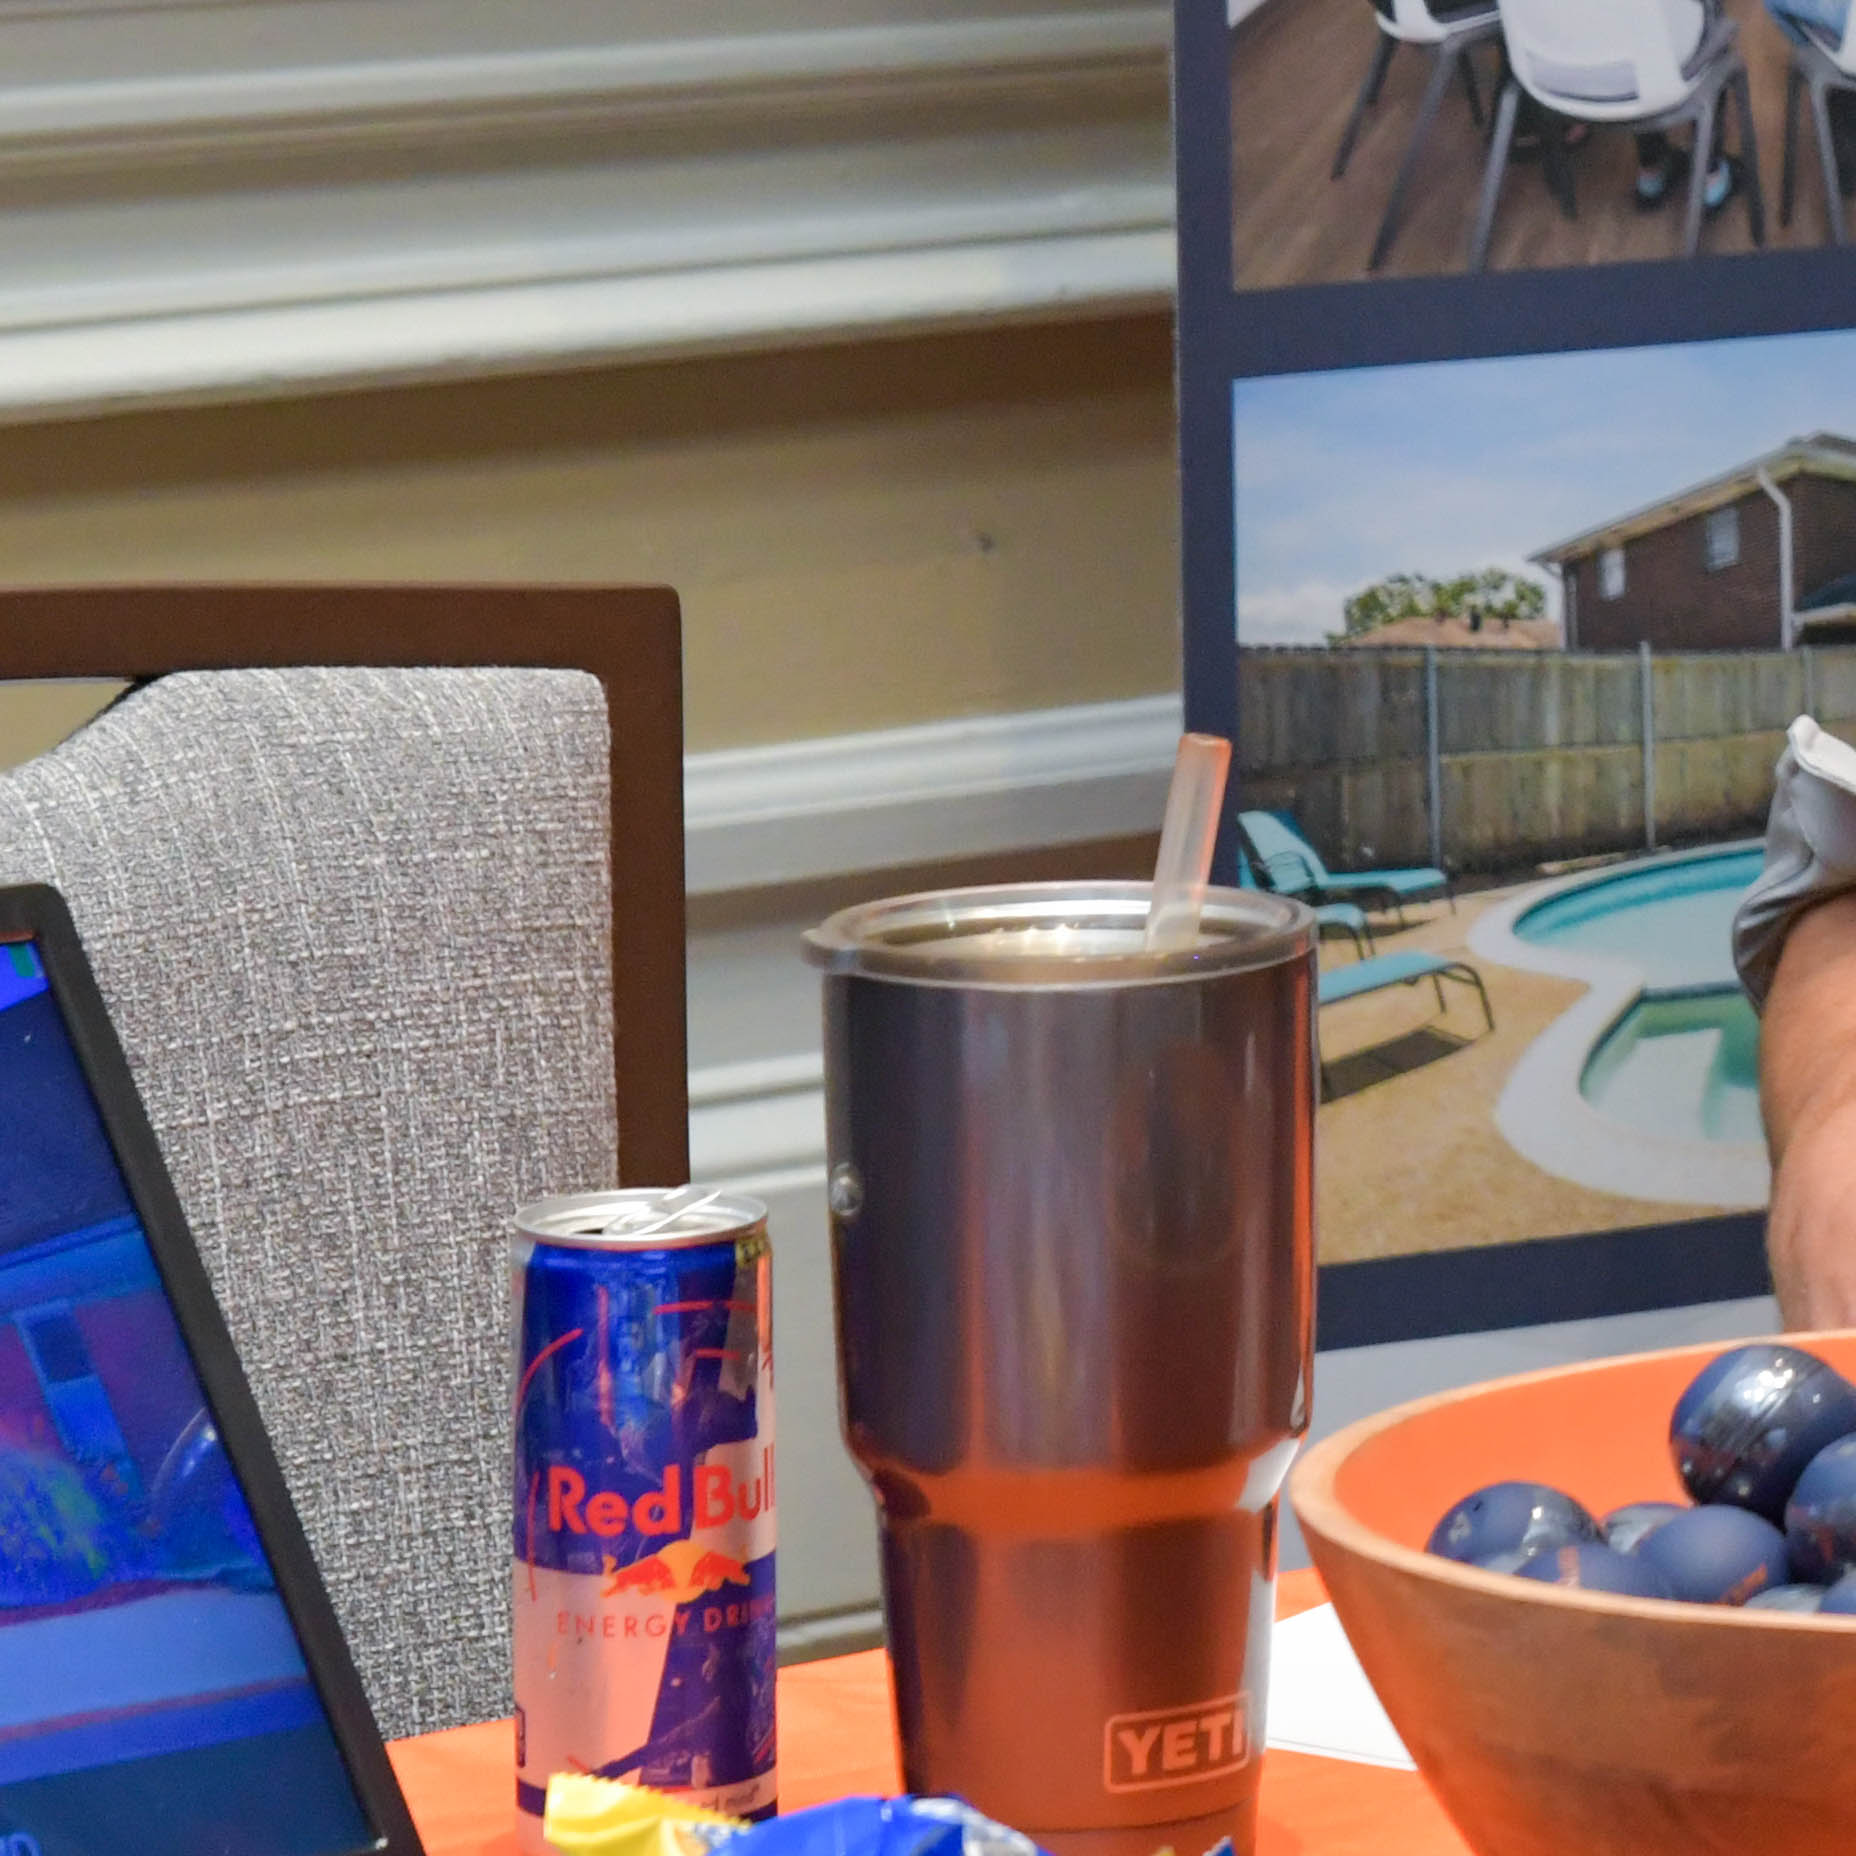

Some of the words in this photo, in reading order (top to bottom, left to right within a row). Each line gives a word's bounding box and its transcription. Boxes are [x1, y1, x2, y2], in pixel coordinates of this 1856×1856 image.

[548, 1464, 681, 1536] Red
[693, 1443, 776, 1530] Bull
[557, 1610, 690, 1639] ENERGY
[704, 1594, 775, 1633] DRI
[1117, 1708, 1244, 1776] YETI
